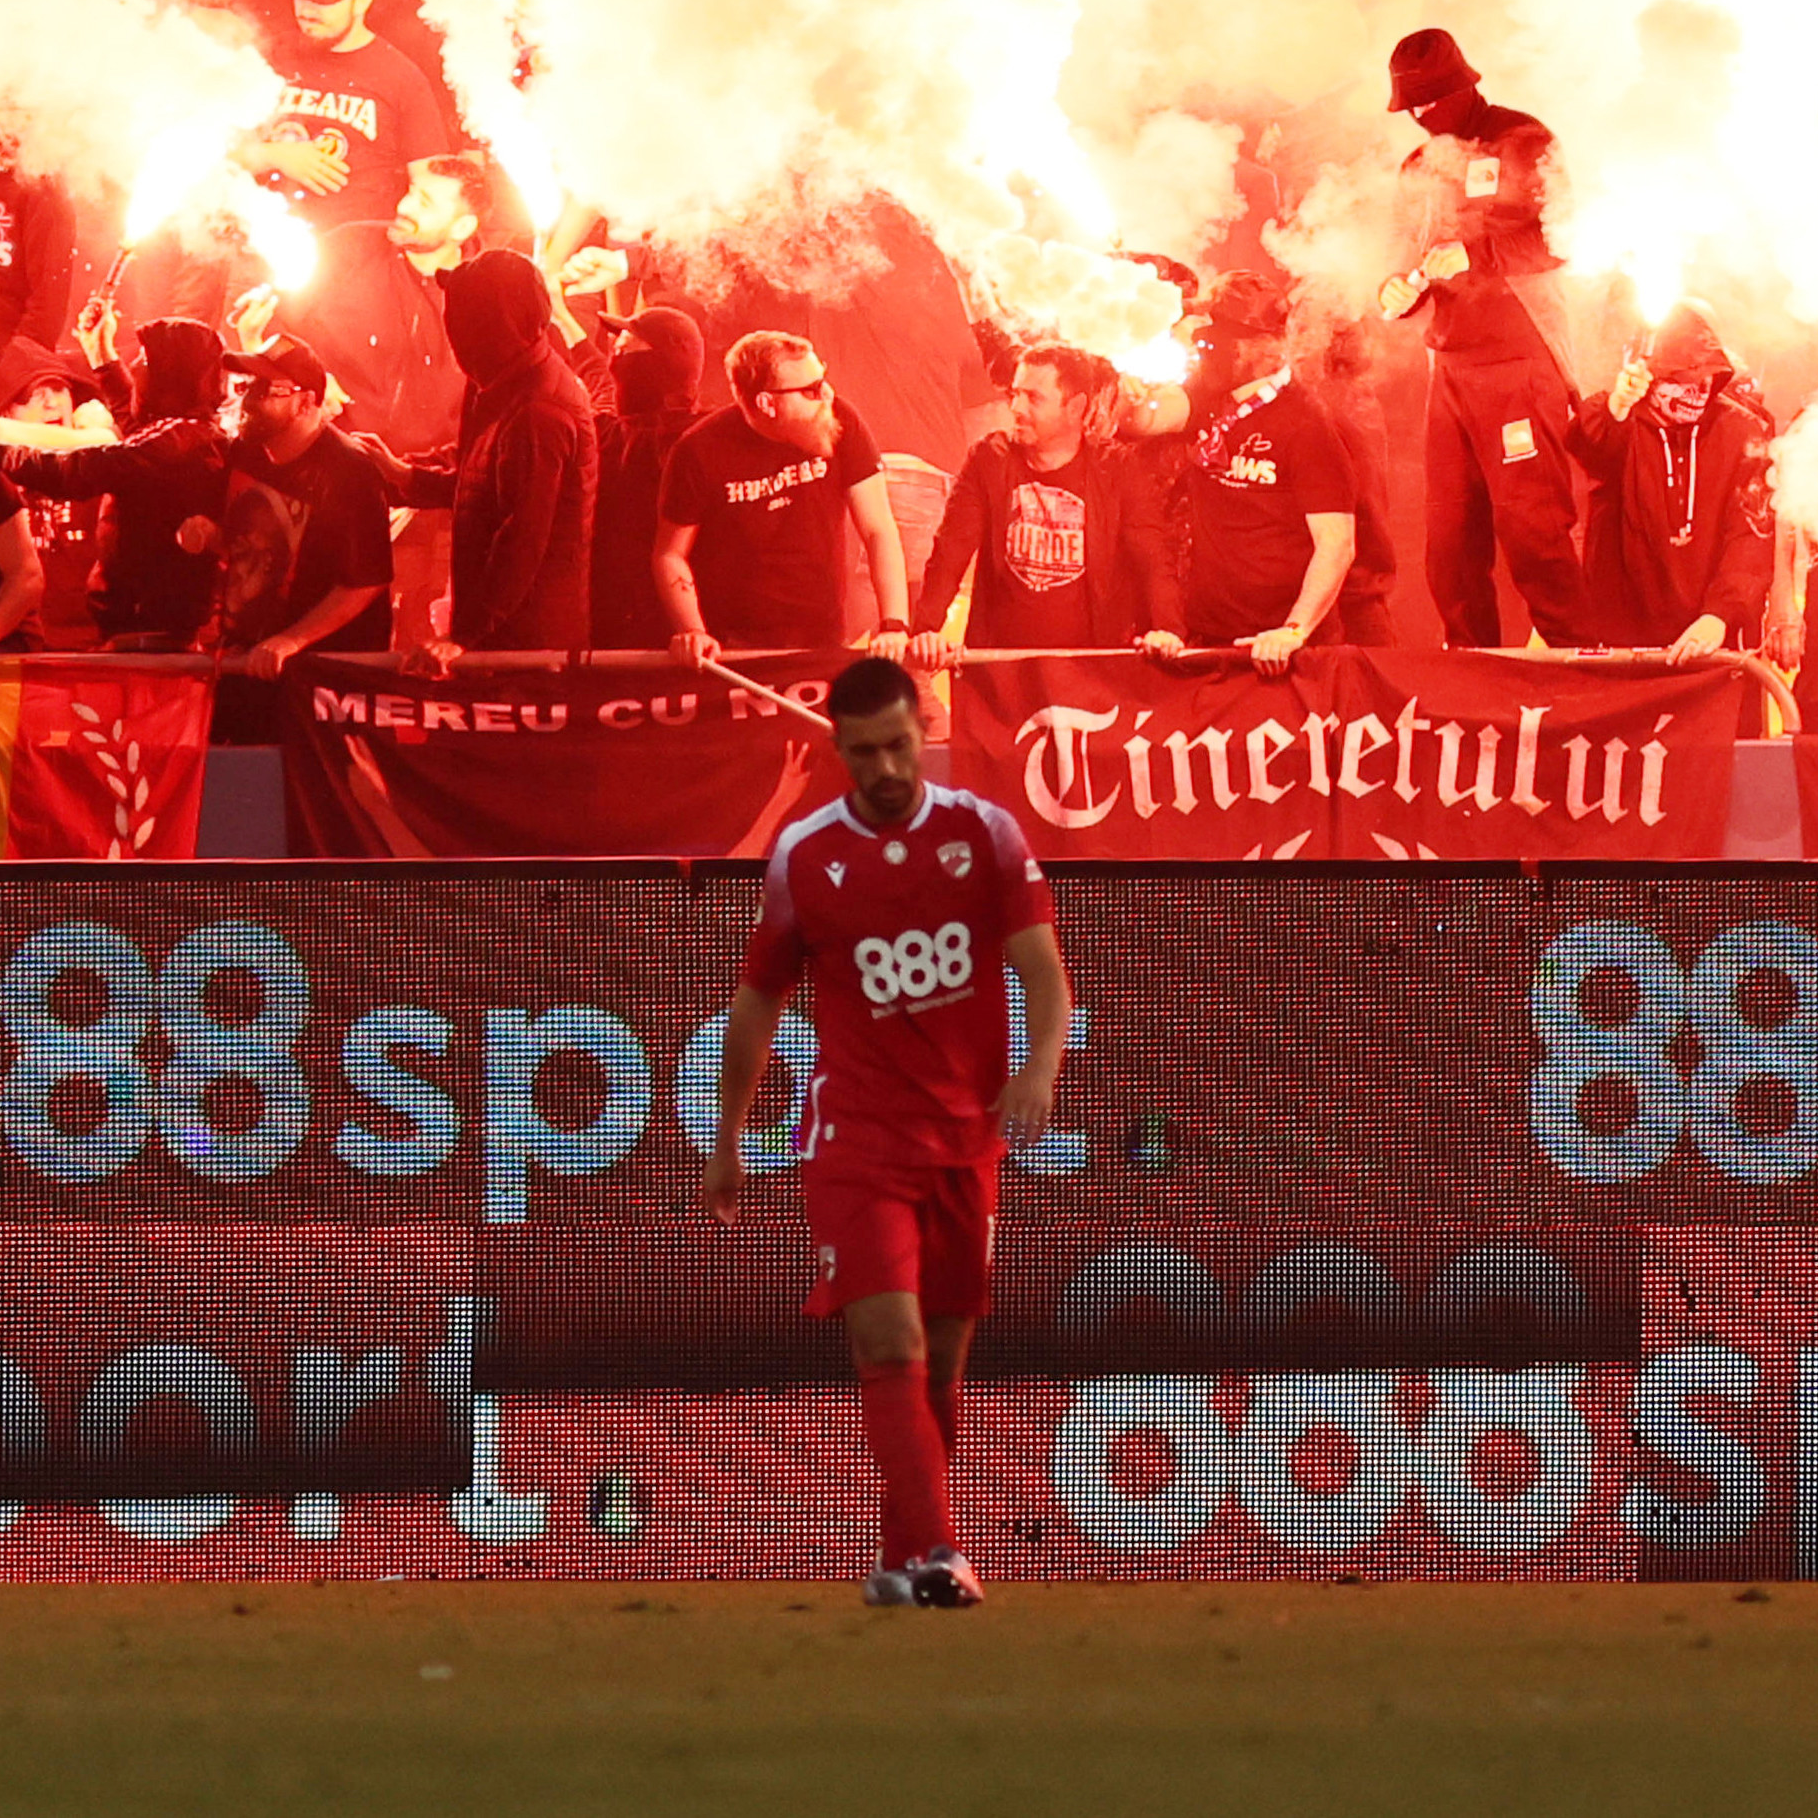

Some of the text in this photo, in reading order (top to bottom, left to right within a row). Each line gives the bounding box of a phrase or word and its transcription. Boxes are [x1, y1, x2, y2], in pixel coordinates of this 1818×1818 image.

[278, 86, 377, 141] TEAUA
[313, 686, 568, 733] MEREU
[597, 692, 698, 730] CU
[1014, 695, 1673, 830] Tineretului
[854, 921, 973, 1004] 888
